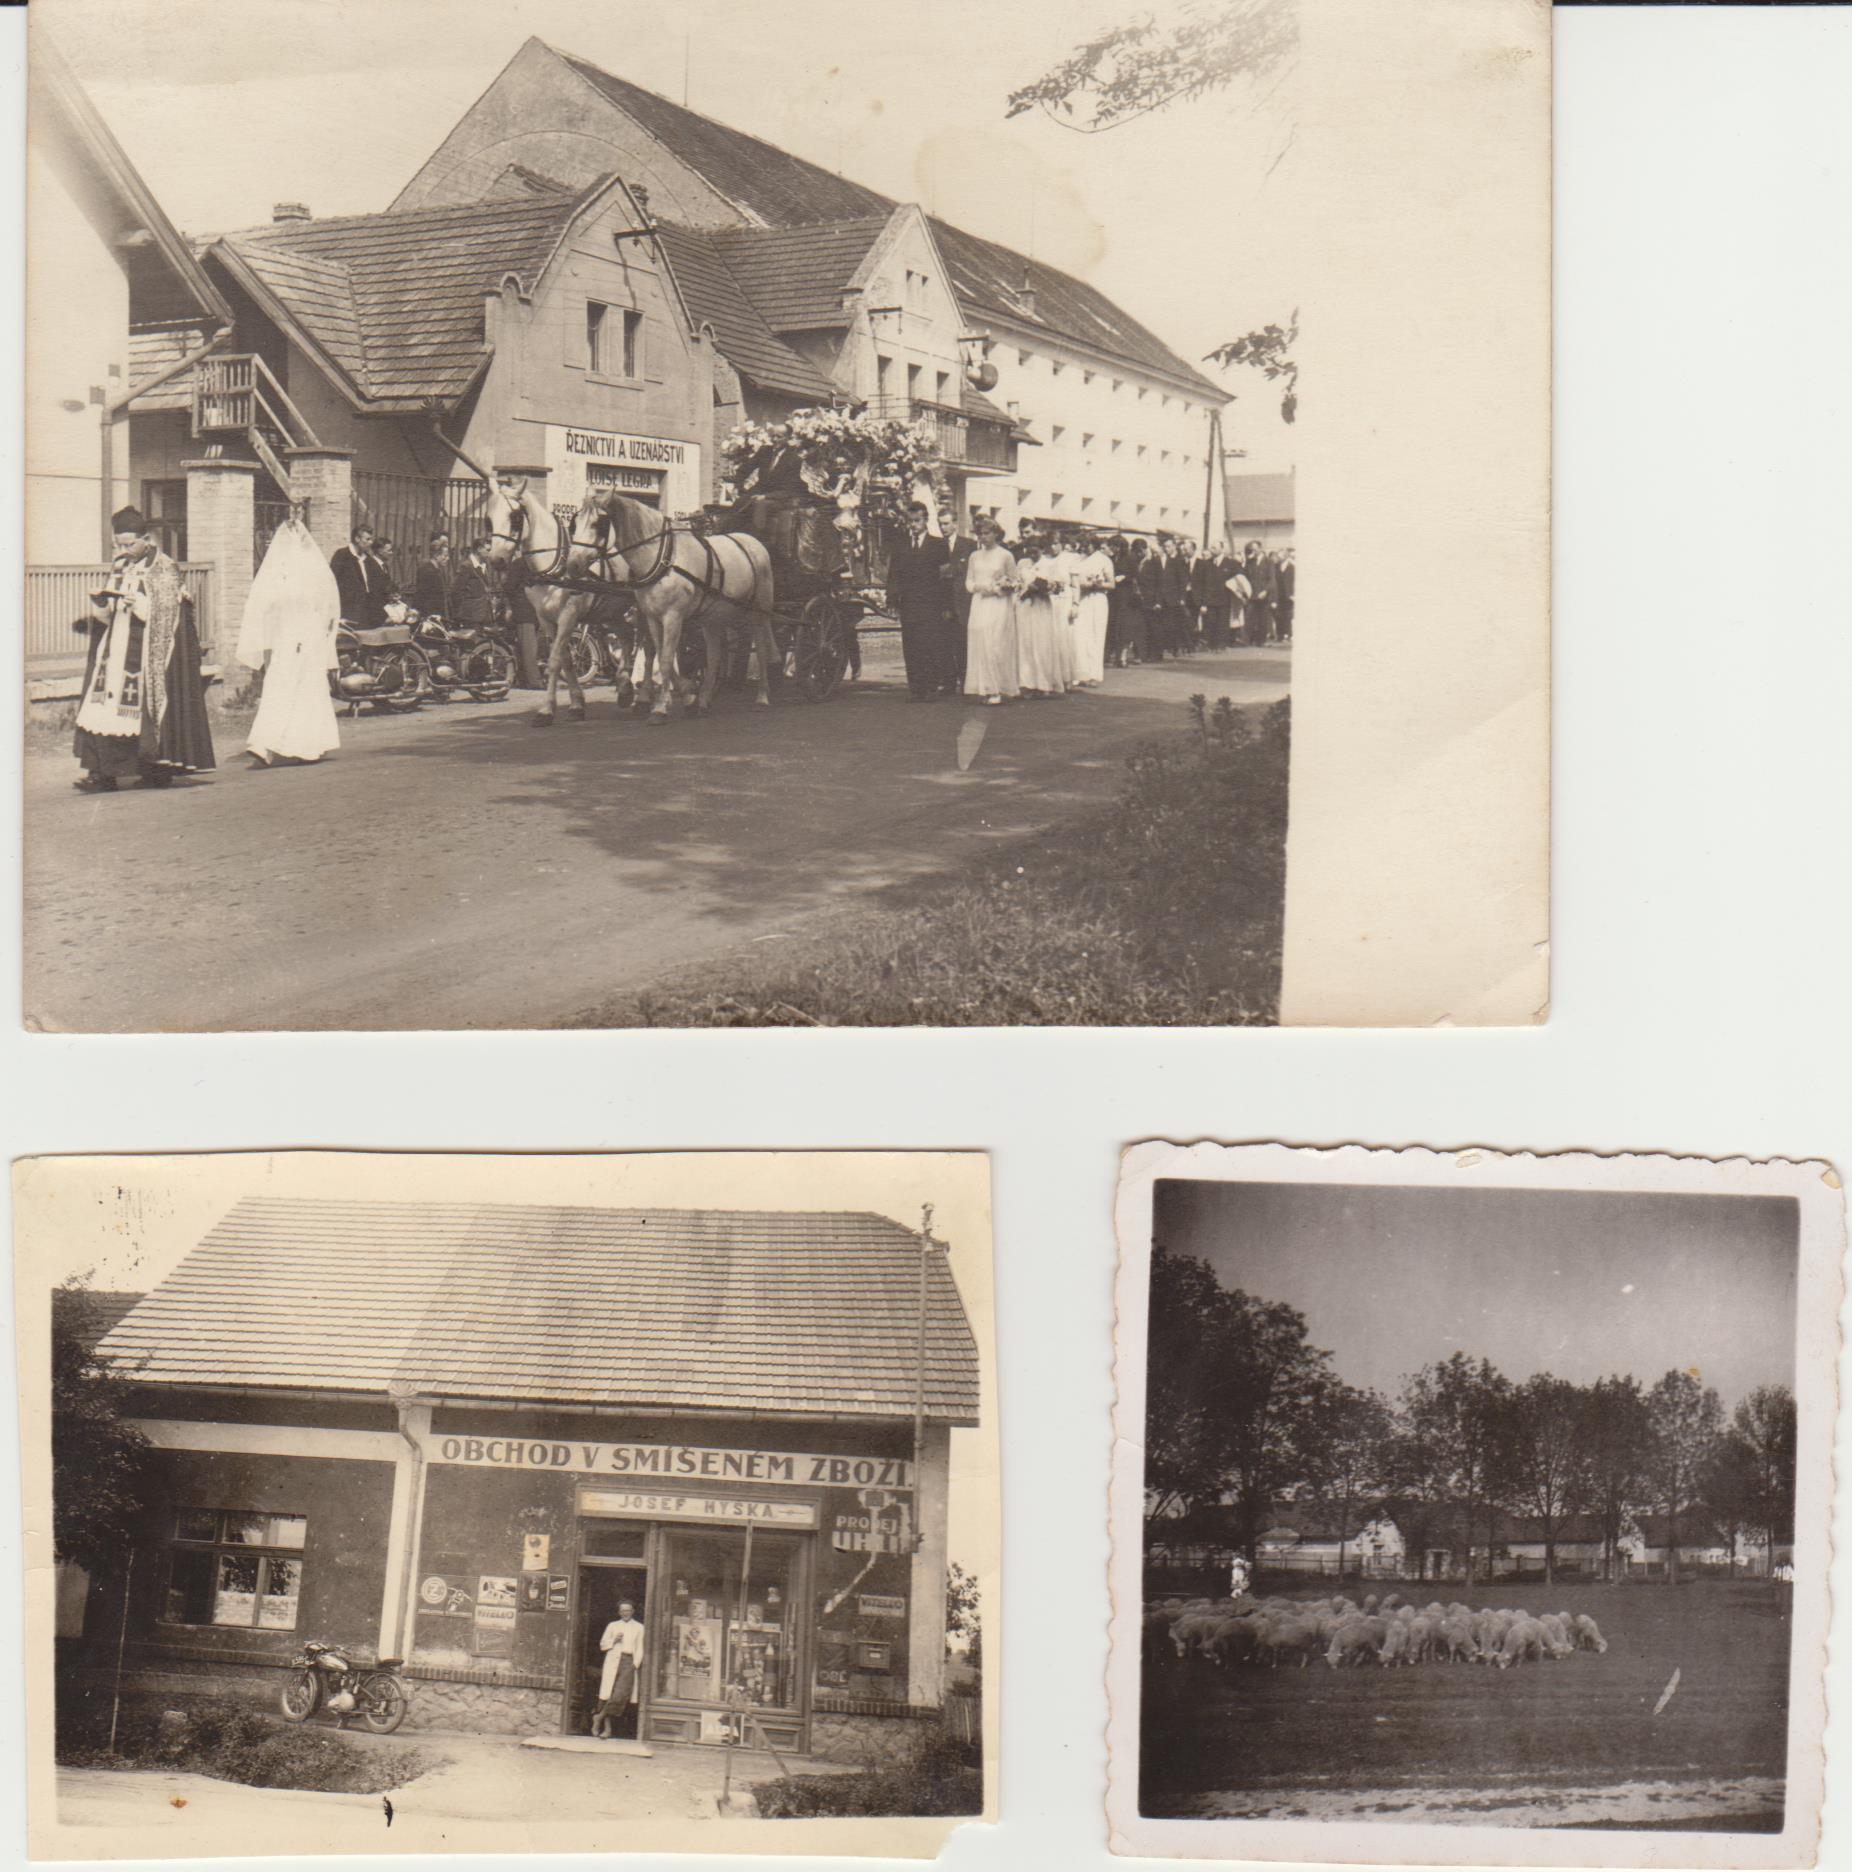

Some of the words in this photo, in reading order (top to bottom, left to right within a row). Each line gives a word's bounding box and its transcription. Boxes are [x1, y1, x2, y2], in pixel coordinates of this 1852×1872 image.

[618, 440, 626, 459] A
[441, 1437, 572, 1467] OBCHOD
[582, 1446, 602, 1468] V
[611, 1445, 794, 1480] SMÍŠENÉM
[618, 1495, 687, 1511] JOSEF
[835, 1514, 898, 1534] PRODEJ
